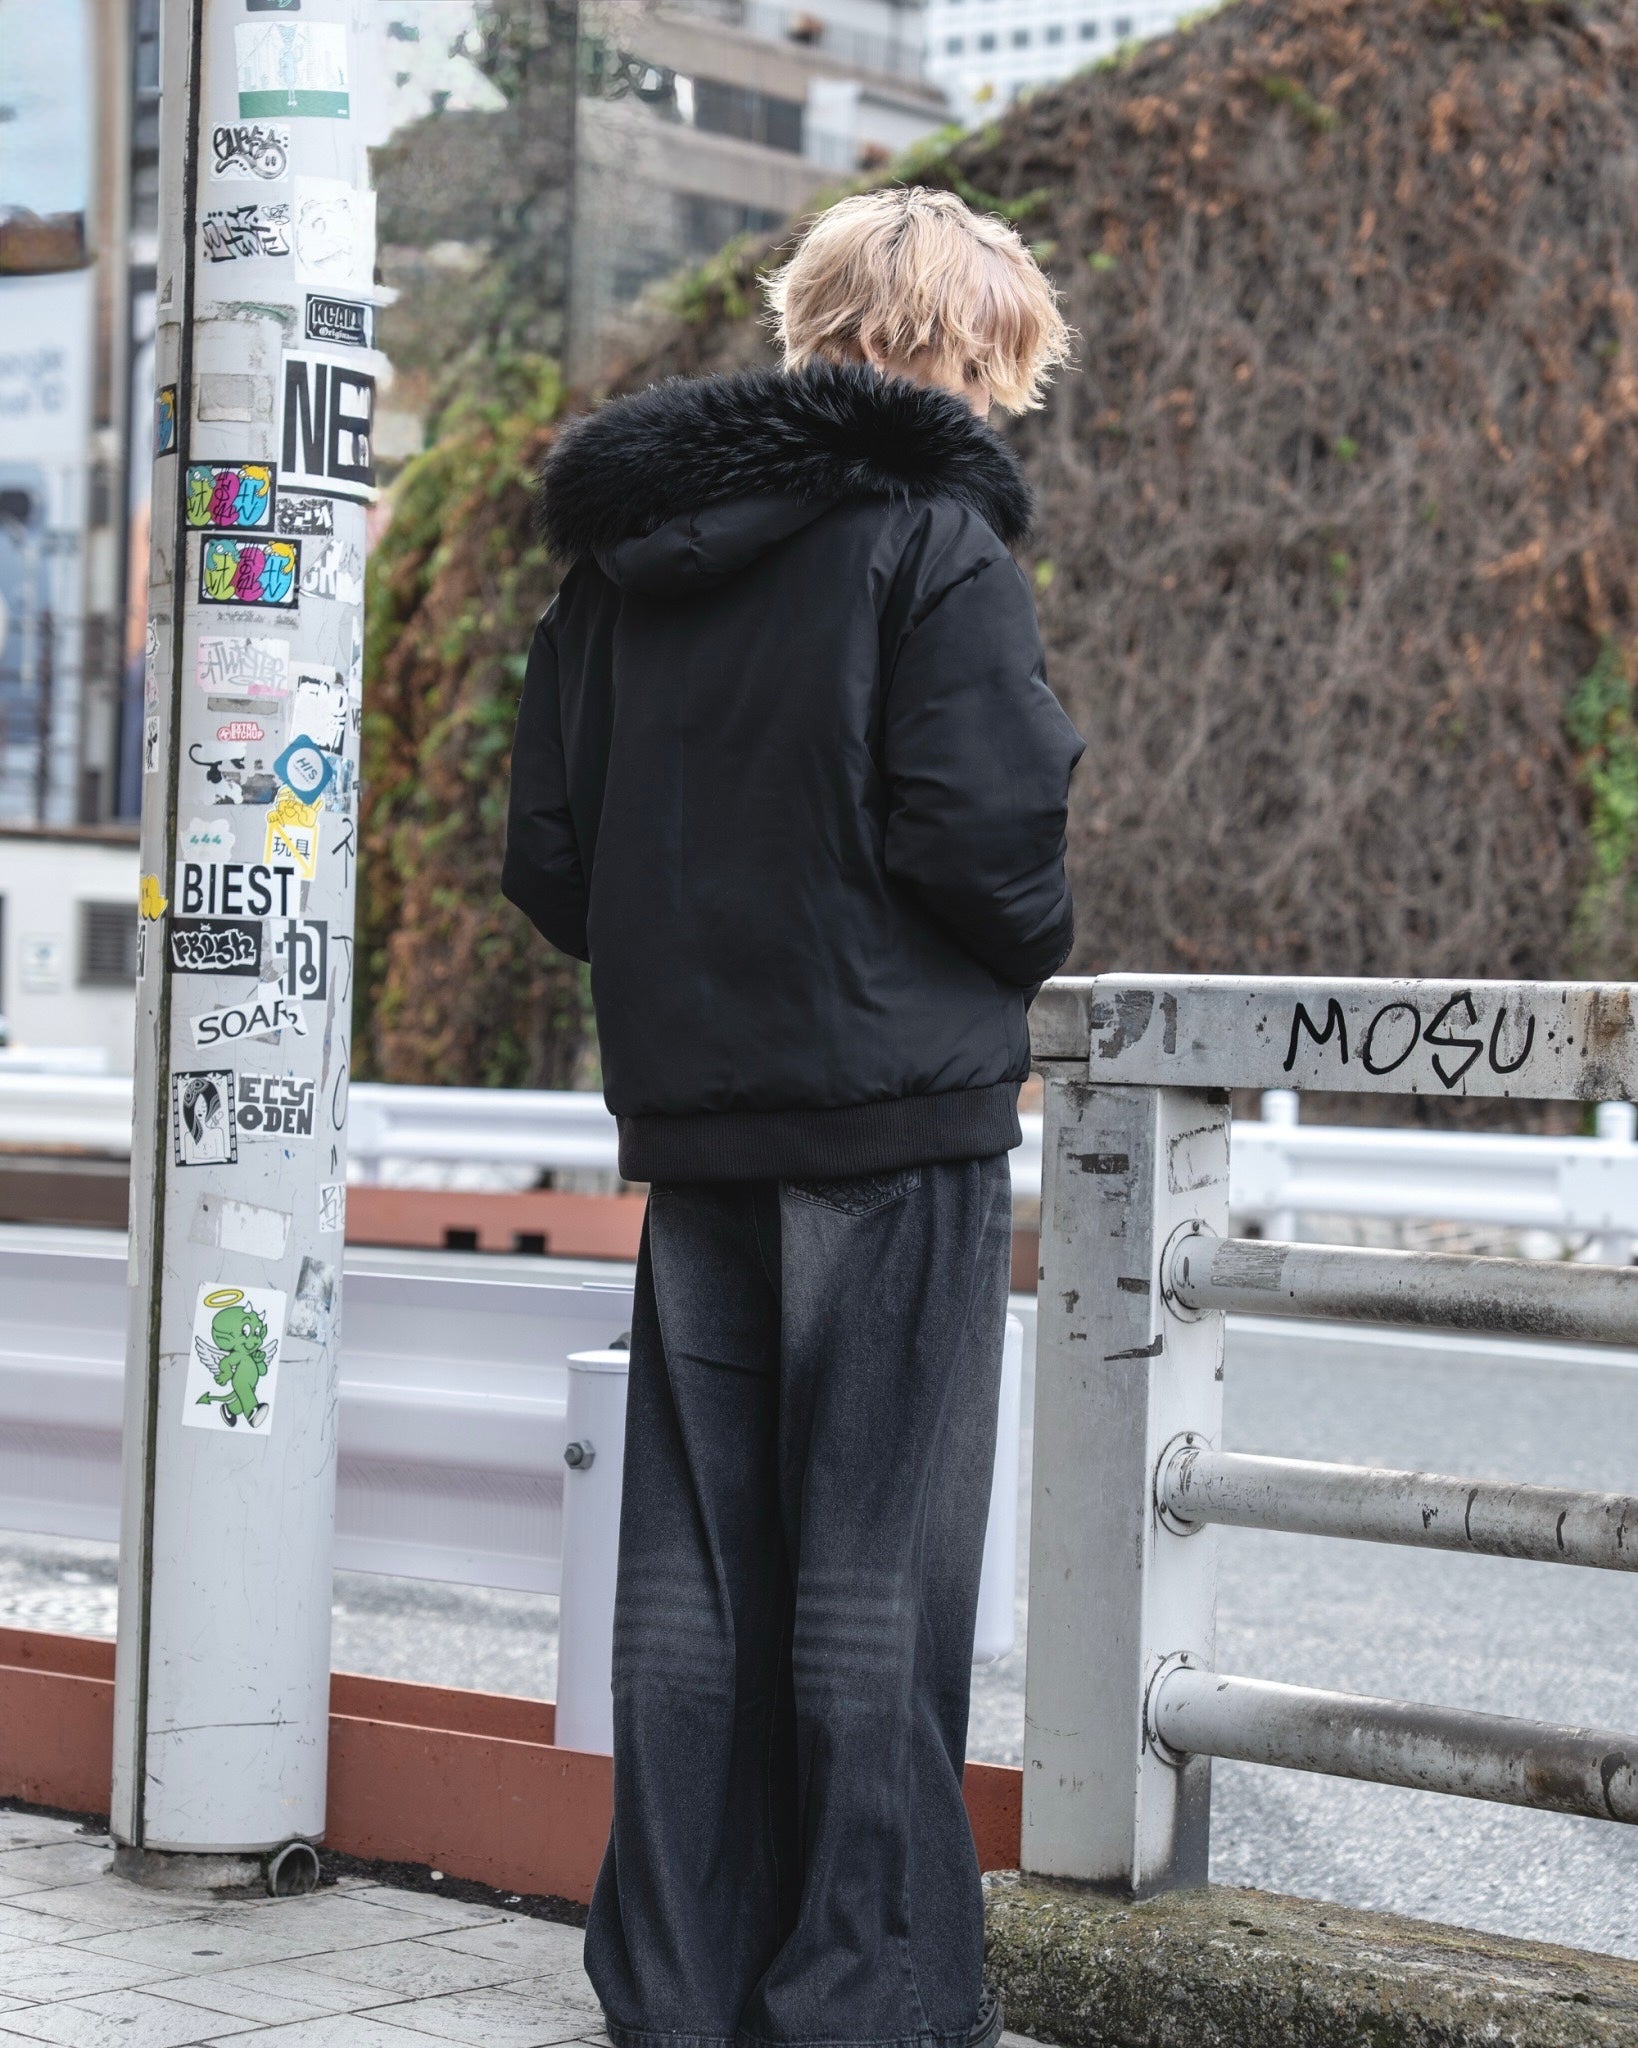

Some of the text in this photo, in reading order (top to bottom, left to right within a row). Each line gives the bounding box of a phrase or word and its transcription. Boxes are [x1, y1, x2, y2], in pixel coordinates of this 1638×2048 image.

[231, 722, 258, 731] EXTRA
[297, 757, 318, 780] HIS
[273, 836, 310, 859] 玩具
[182, 863, 295, 916] BIEST
[1283, 991, 1535, 1088] MOSU
